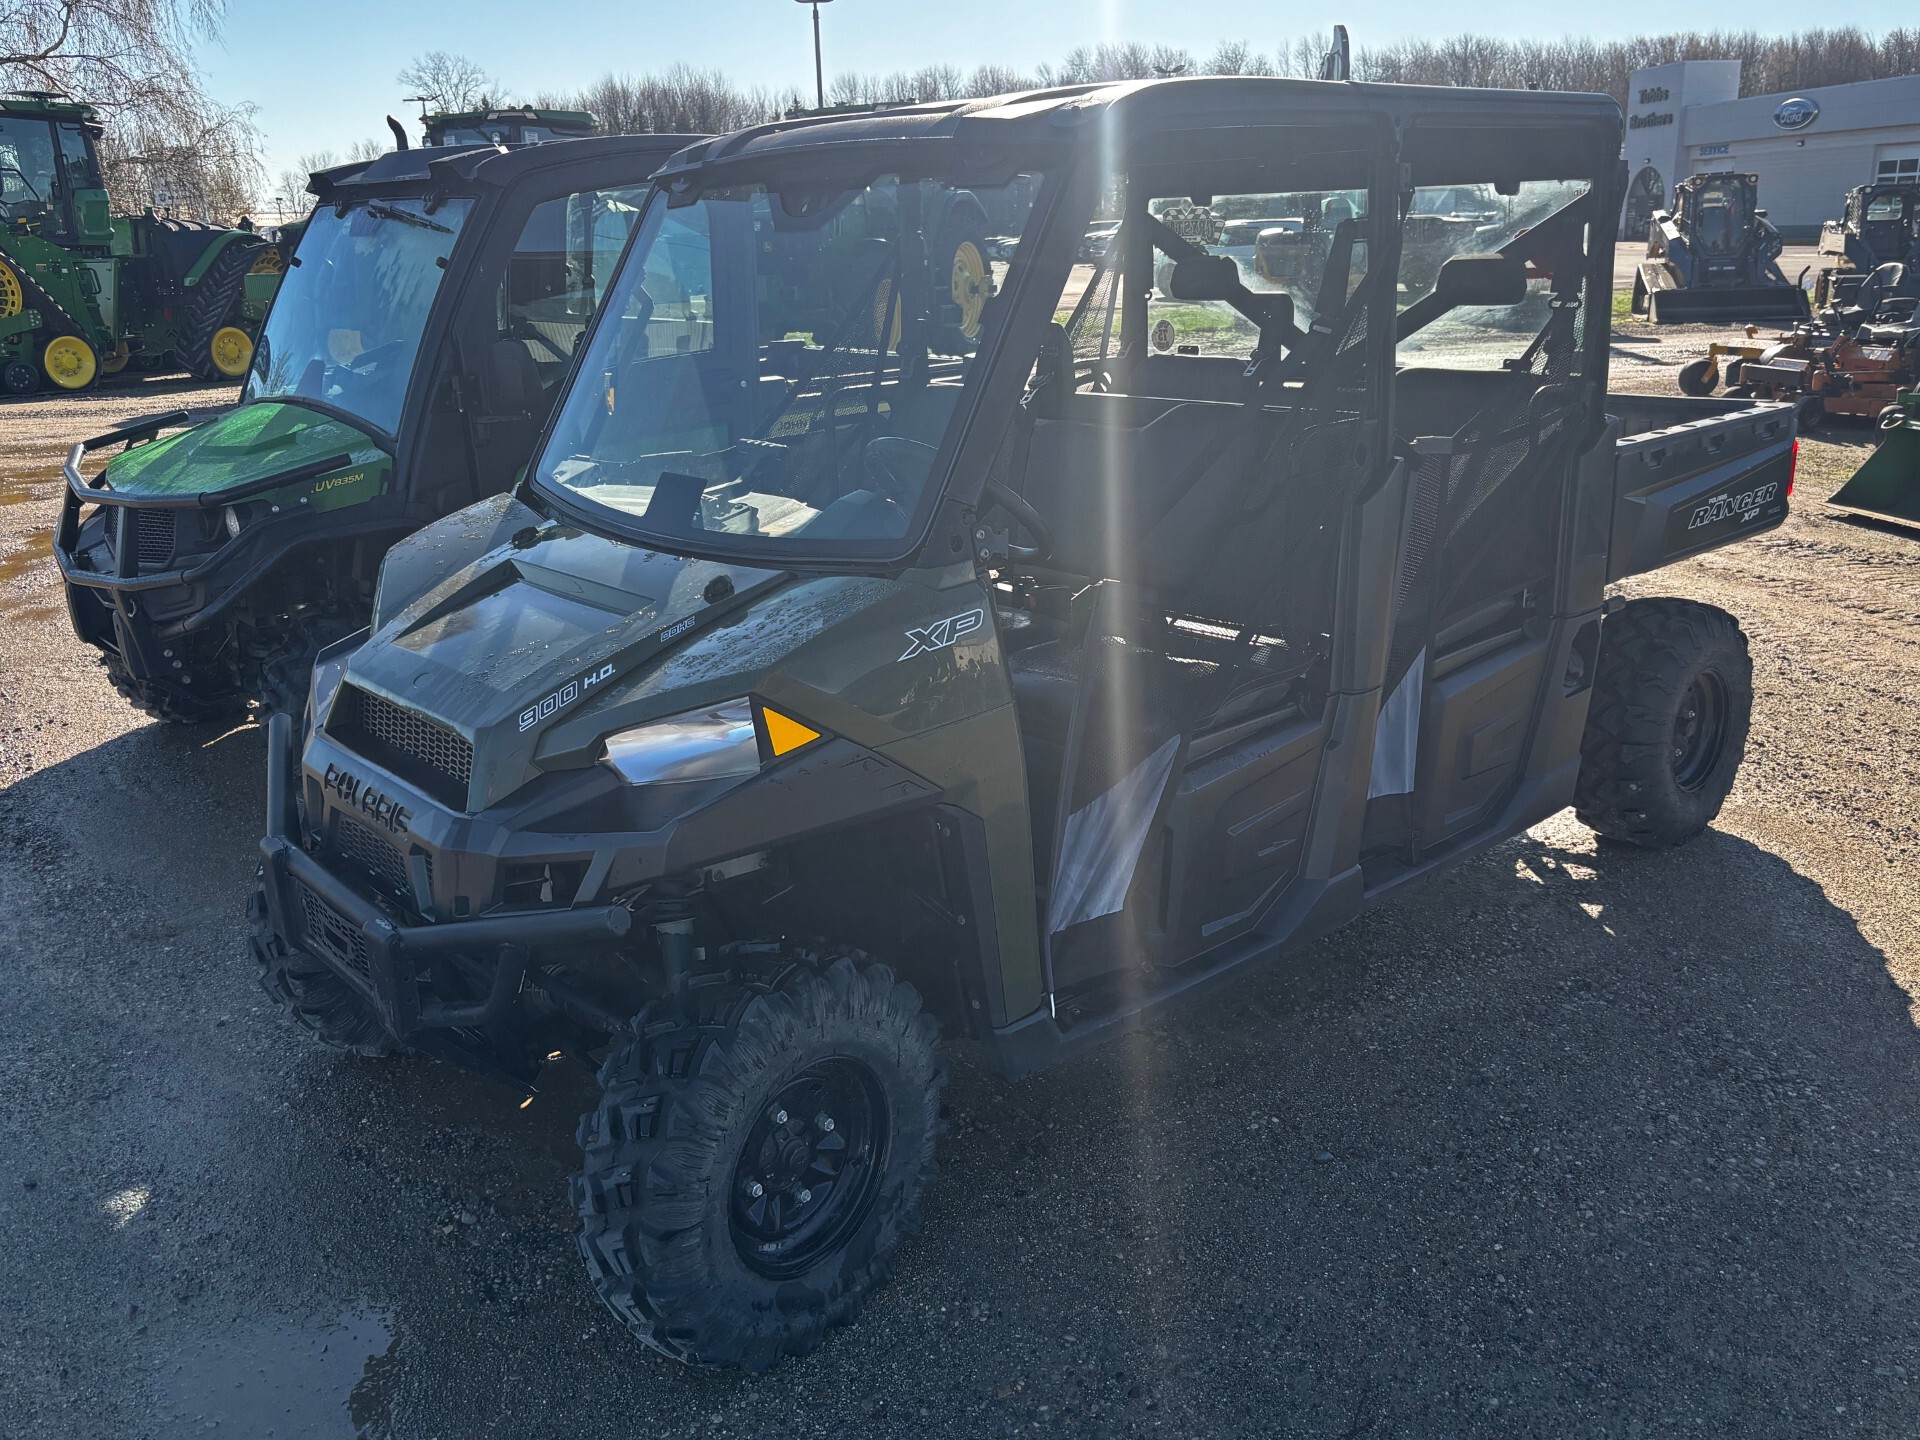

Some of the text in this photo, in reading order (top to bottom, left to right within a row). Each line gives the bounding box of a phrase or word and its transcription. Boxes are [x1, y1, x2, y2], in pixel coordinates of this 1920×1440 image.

[1629, 112, 1673, 130] Brothers
[1779, 106, 1804, 124] Ford
[1699, 144, 1729, 156] SERVICE
[311, 473, 365, 493] UV835M
[1688, 482, 1778, 530] RANGER
[1709, 493, 1728, 505] POLARIS
[1740, 508, 1760, 523] XP
[660, 616, 696, 643] DOHC
[896, 608, 984, 662] XP
[519, 663, 616, 732] 900 H.O.
[324, 763, 412, 834] POLARIS
